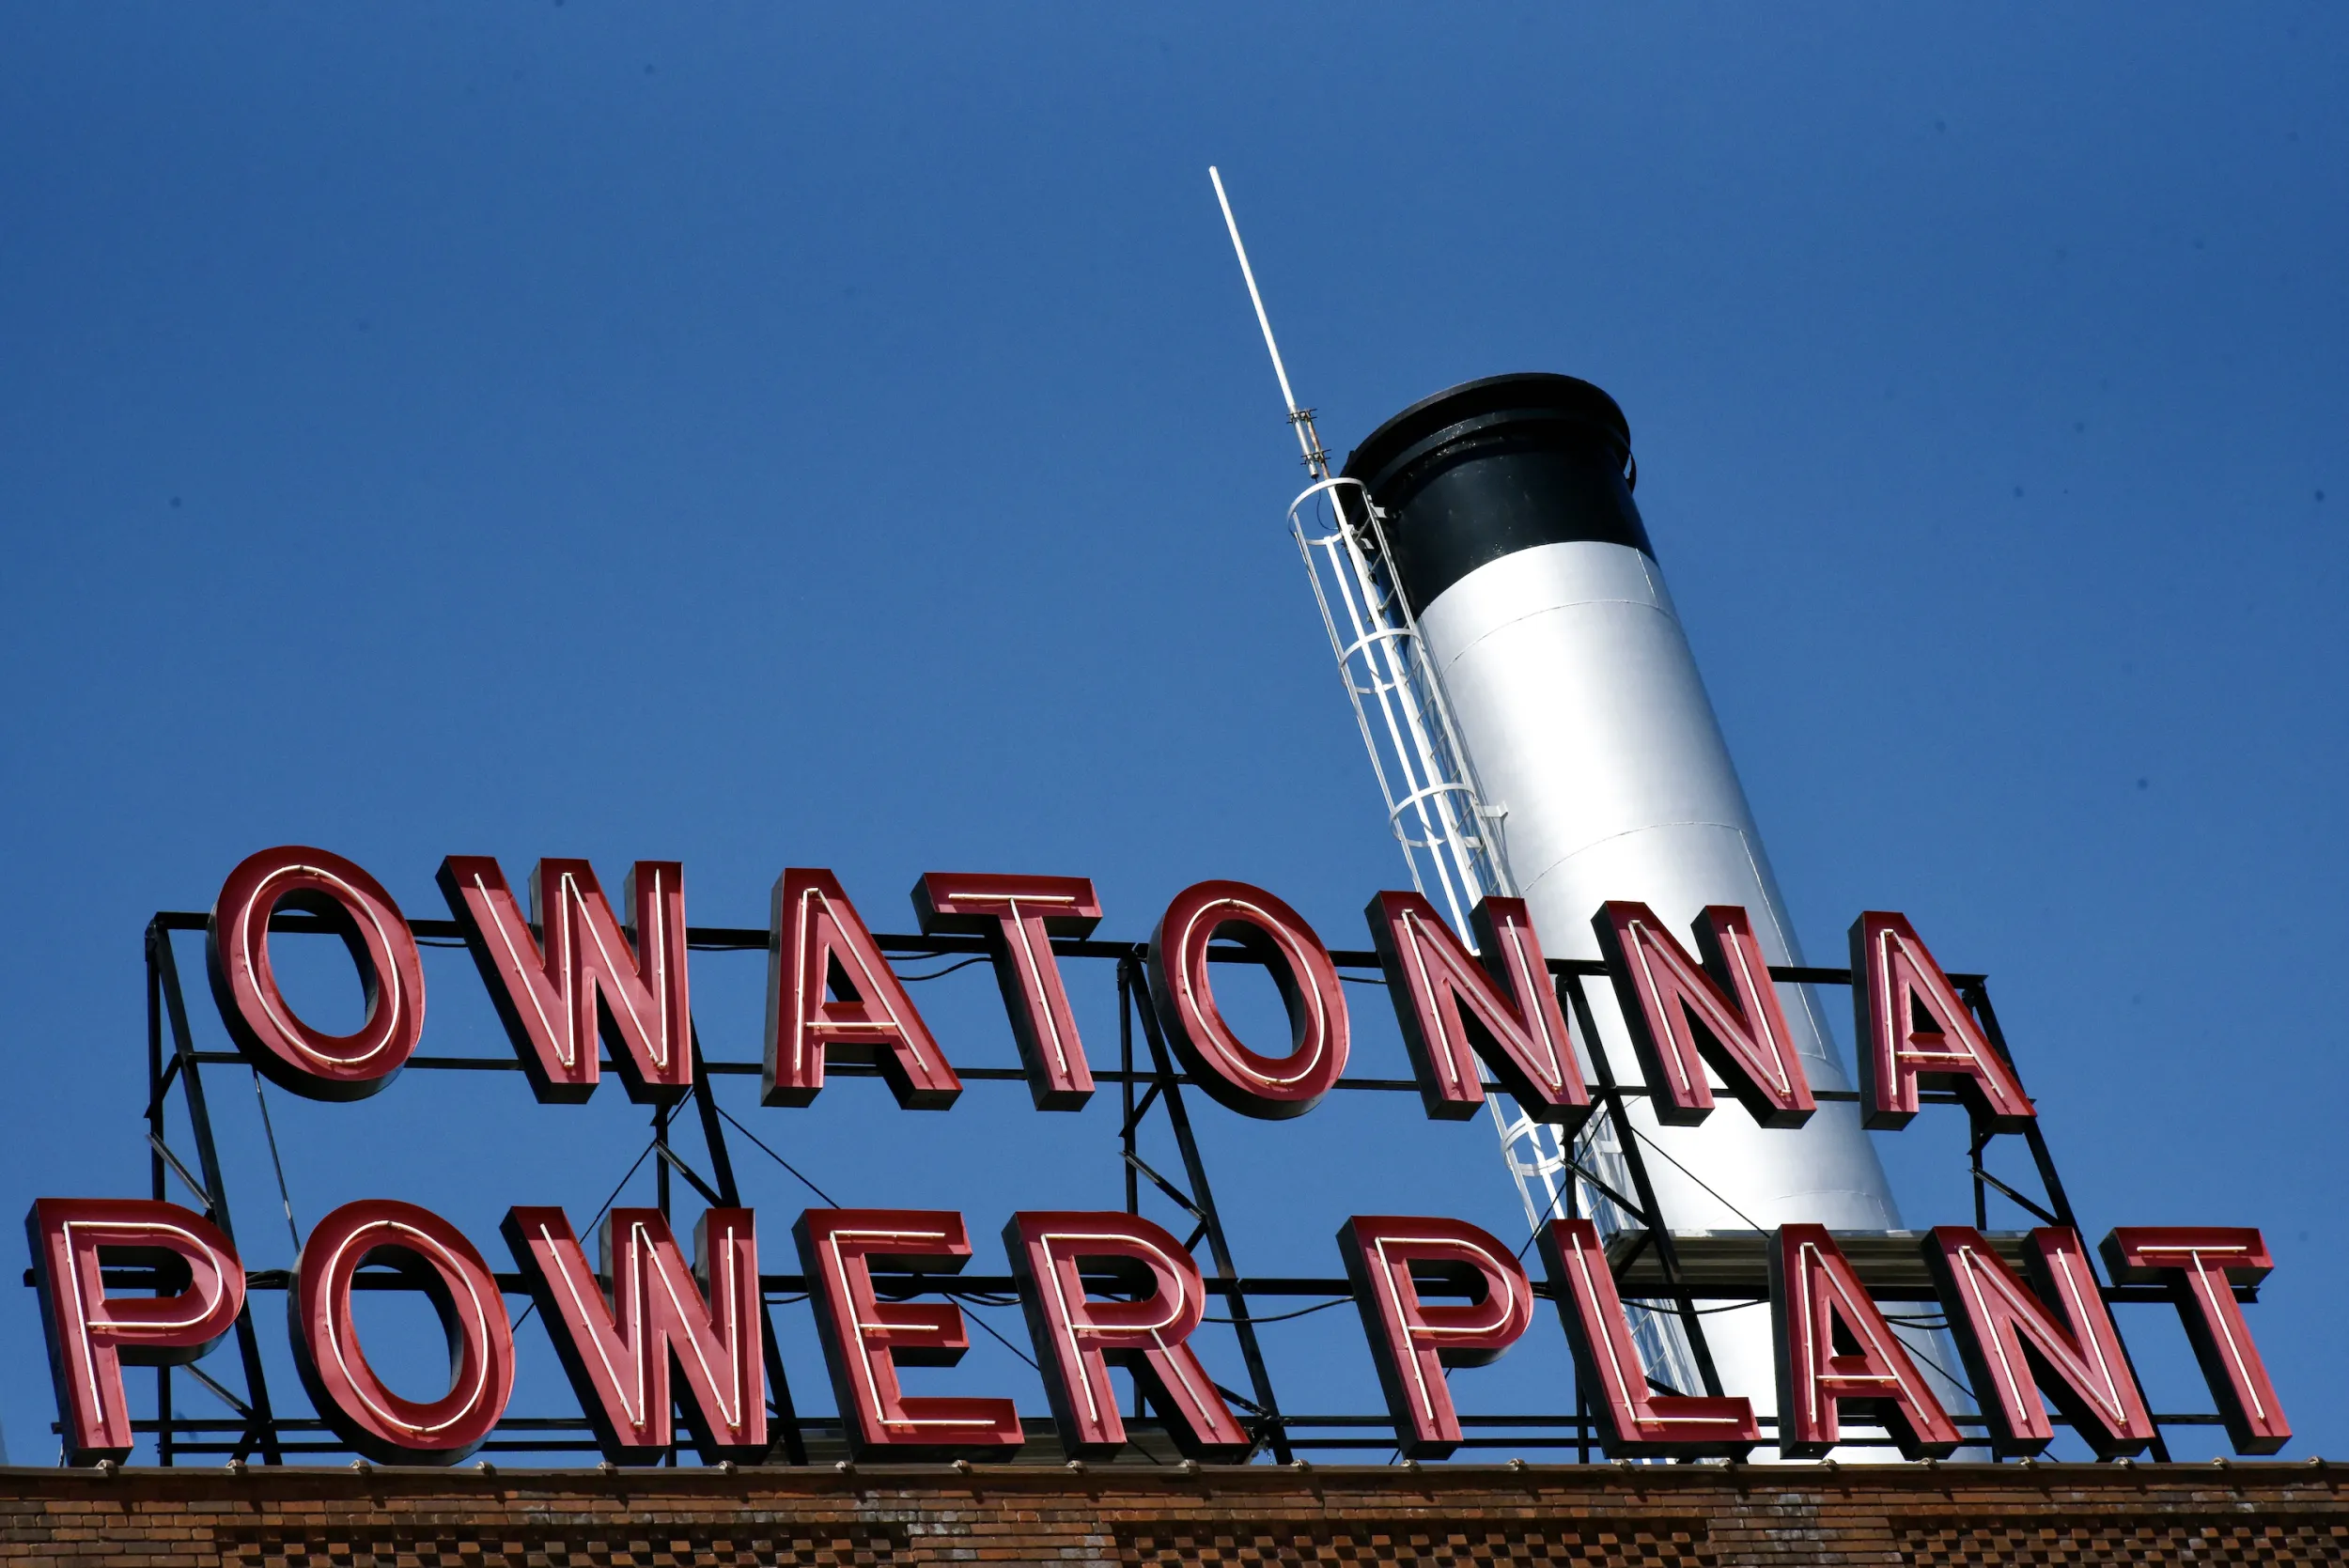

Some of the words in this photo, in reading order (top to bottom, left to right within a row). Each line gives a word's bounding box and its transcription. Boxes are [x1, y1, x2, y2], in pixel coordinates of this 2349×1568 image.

[207, 845, 2038, 1135] OWATONNA
[24, 1197, 1252, 1466] POWER
[1336, 1214, 2293, 1461] PLANT
